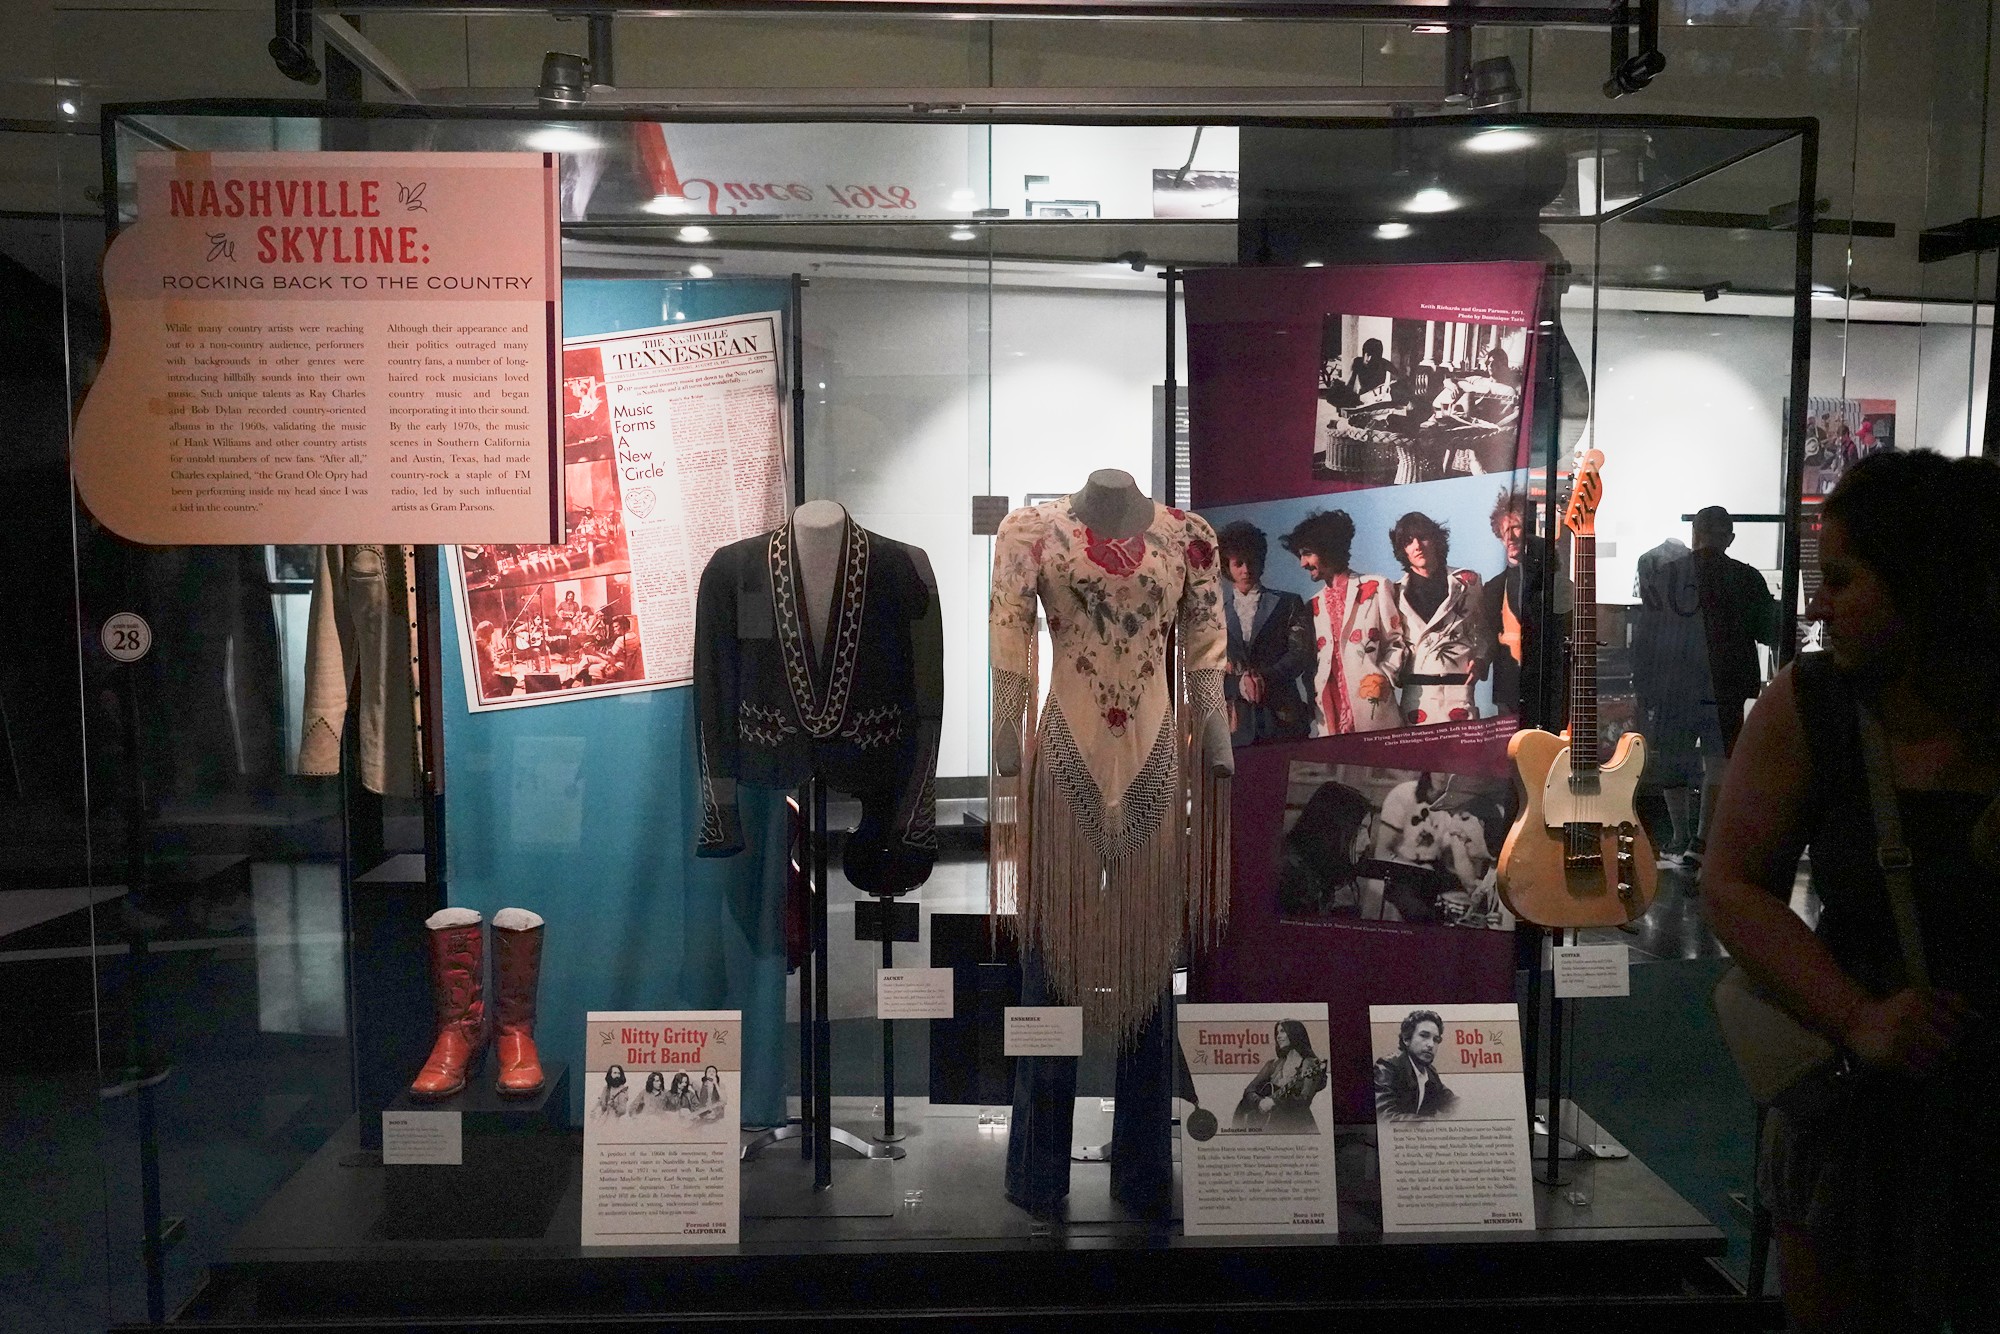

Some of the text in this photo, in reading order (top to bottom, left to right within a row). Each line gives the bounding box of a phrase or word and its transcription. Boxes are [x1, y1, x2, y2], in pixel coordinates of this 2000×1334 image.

[169, 179, 381, 218] NASHVILLE
[257, 225, 430, 264] SKYLINE:
[163, 276, 533, 290] ROCKING BACK TO THE COUNTRY
[166, 322, 364, 336] While many country artists were reaching
[387, 322, 528, 336] Although their appearance and
[166, 340, 180, 350] out
[186, 340, 194, 350] to
[316, 339, 364, 352] performers
[388, 339, 528, 352] their politics outraged many
[642, 338, 664, 349] THE
[612, 335, 758, 370] TENNESSEAN
[167, 355, 364, 368] with backgrounds in other genres were
[388, 356, 421, 368] country
[425, 355, 445, 368] fans,
[456, 355, 490, 366] number
[493, 355, 503, 366] of
[506, 355, 528, 368] long-
[388, 371, 529, 382] haired rock musicians loved
[389, 387, 529, 401] country music and began
[389, 404, 529, 417] incorporating it into their sound.
[613, 402, 653, 418] Music
[169, 420, 200, 431] albums
[206, 420, 214, 431] in
[220, 420, 233, 431] the
[273, 420, 316, 433] validating
[322, 420, 335, 431] the
[341, 420, 366, 431] music
[390, 420, 529, 433] By the early 1970s, the music
[615, 420, 656, 434] Forms
[390, 436, 530, 447] scenes in Southern California
[618, 436, 630, 449] A
[390, 452, 530, 465] and Austin, Texas, had made
[619, 450, 652, 464] New
[171, 469, 205, 480] Charles
[275, 469, 304, 480] Grand
[306, 469, 322, 480] Ole
[325, 469, 348, 482] Opry
[351, 469, 367, 480] had
[390, 469, 449, 482] country-rock
[466, 469, 492, 482] staple
[498, 469, 508, 480] of
[515, 469, 530, 480] FM
[172, 485, 192, 496] been
[196, 485, 245, 498] performing
[249, 485, 274, 496] inside
[278, 488, 290, 498] my
[295, 485, 316, 496] head
[319, 485, 341, 496] since
[352, 488, 368, 496] was
[391, 485, 531, 498] radio, led by such influential
[392, 501, 494, 512] artists as Gram Parsons.
[113, 630, 140, 651] 28
[621, 1027, 709, 1048] Nitty Gritty
[1198, 1029, 1270, 1051] Emmylou
[1455, 1029, 1484, 1045] Bob
[627, 1047, 701, 1064] Dirt Band
[1214, 1049, 1261, 1065] Harris
[1460, 1048, 1503, 1068] Dylan
